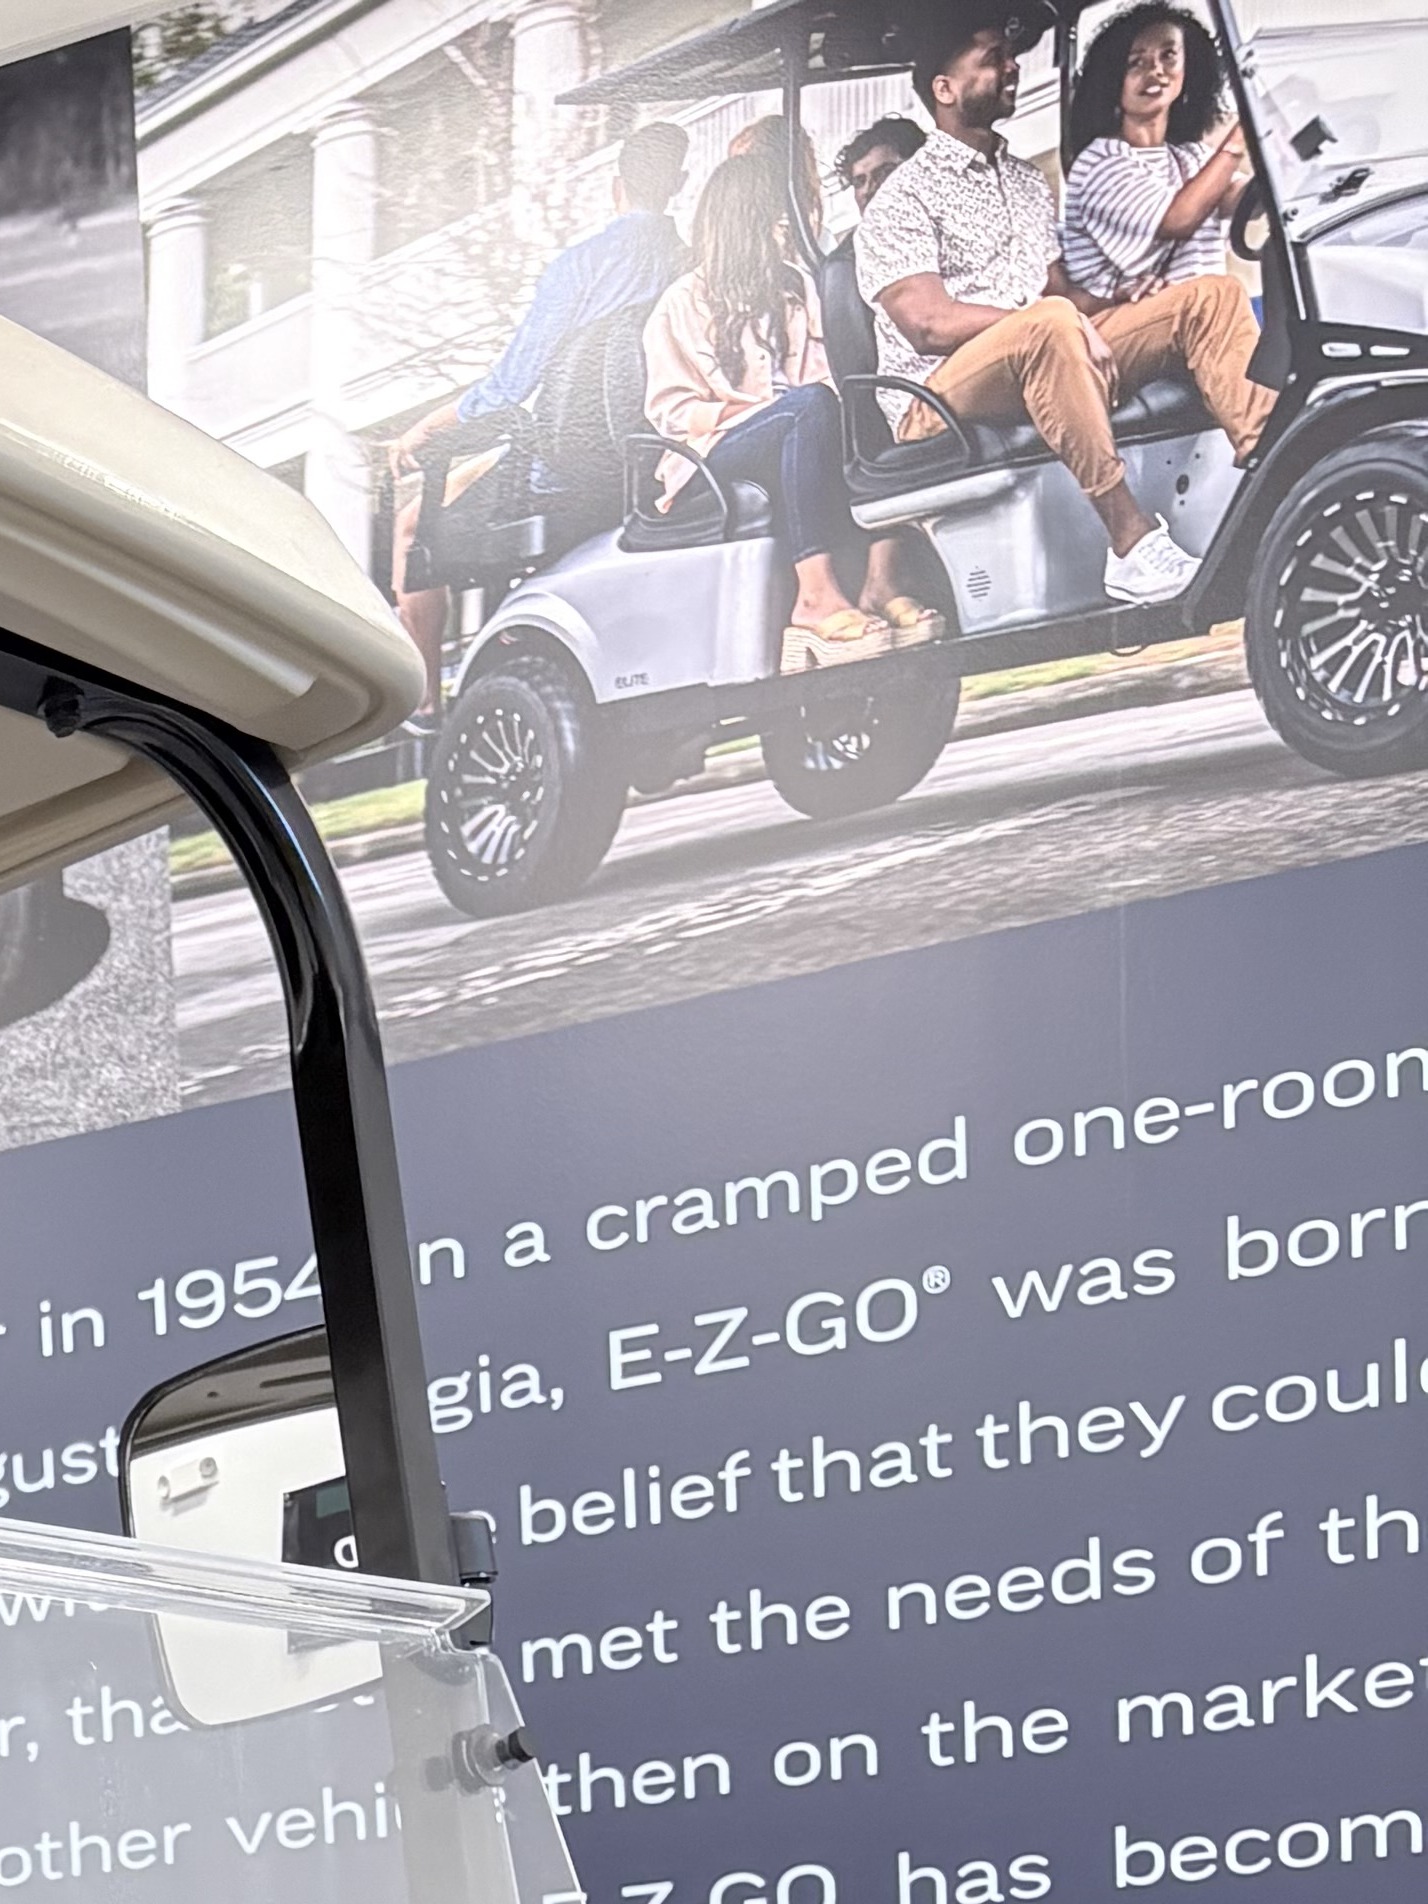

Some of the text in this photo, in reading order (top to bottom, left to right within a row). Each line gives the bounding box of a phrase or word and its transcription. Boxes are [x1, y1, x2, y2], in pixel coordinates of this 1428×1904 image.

[504, 1220, 552, 1268] a
[586, 1114, 969, 1251] cramped
[39, 1299, 105, 1358] in
[990, 1247, 1176, 1319] was
[519, 1449, 752, 1546] belief
[770, 1422, 954, 1503] that
[975, 1393, 1186, 1470] they
[1211, 1336, 1428, 1433] coul
[521, 1609, 679, 1684] met
[709, 1587, 851, 1655] the
[887, 1535, 1156, 1631] needs
[1190, 1510, 1285, 1585] of
[541, 1751, 731, 1816] then
[773, 1732, 879, 1787] on
[920, 1699, 1070, 1767] the
[1117, 1652, 1428, 1743] marke
[1114, 1808, 1425, 1889] becom
